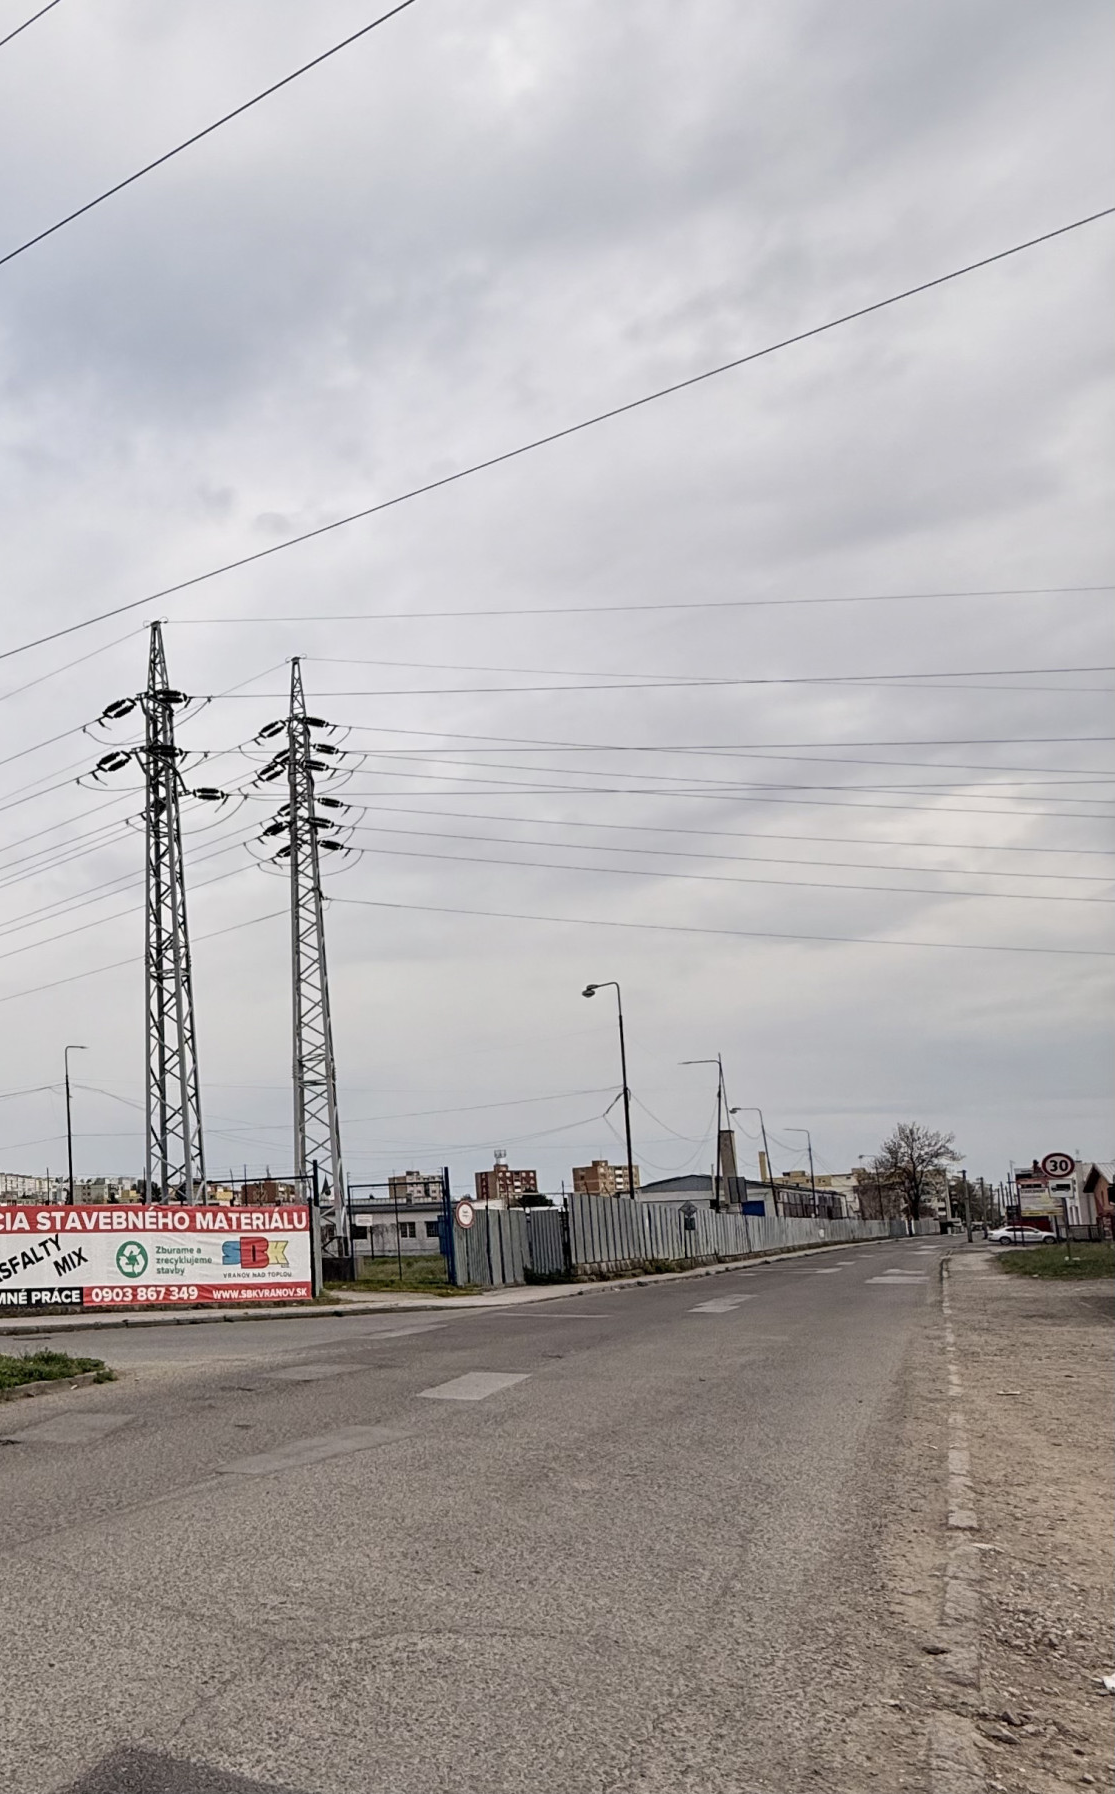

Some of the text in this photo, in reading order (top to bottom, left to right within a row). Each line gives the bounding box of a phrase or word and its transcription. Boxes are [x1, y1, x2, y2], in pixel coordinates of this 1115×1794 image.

[1049, 1160, 1069, 1172] 30
[36, 1207, 189, 1231] STAVEBNÉHO
[196, 1207, 307, 1230] MATERIÁLU
[222, 1236, 289, 1269] SBK
[53, 1246, 89, 1277] MIX
[155, 1256, 213, 1266] zrecyklujeme
[156, 1267, 185, 1276] stavby
[31, 1288, 81, 1304] PRÁCE
[91, 1286, 198, 1302] 0903 867 349
[212, 1287, 307, 1299] WWW.SBKVRANOV.SK
